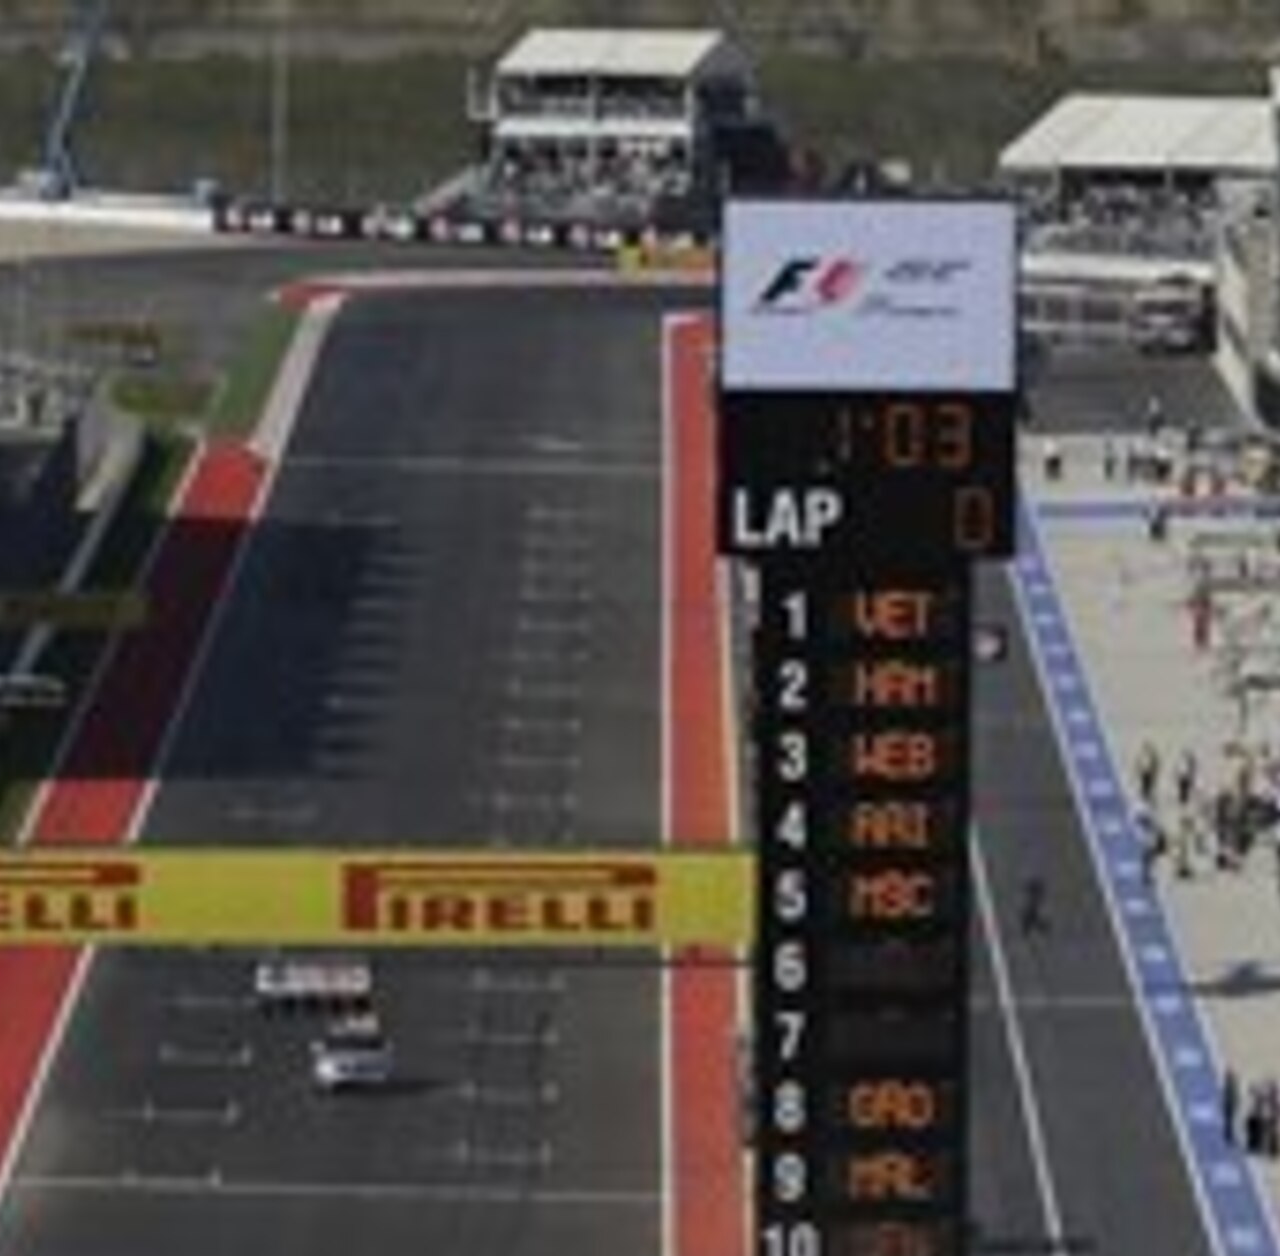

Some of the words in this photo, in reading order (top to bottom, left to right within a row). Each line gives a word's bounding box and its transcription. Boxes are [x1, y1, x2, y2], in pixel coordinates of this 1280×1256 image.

[734, 487, 844, 547] LAP
[781, 590, 808, 640] 1
[777, 659, 809, 710] 2
[777, 732, 808, 782] 3
[776, 802, 807, 849] 4
[341, 861, 657, 932] PIRELLI
[776, 868, 807, 921] 5
[773, 942, 806, 992] 6
[773, 1010, 806, 1061] 7
[773, 1080, 806, 1133] 8
[773, 1153, 806, 1202] 9
